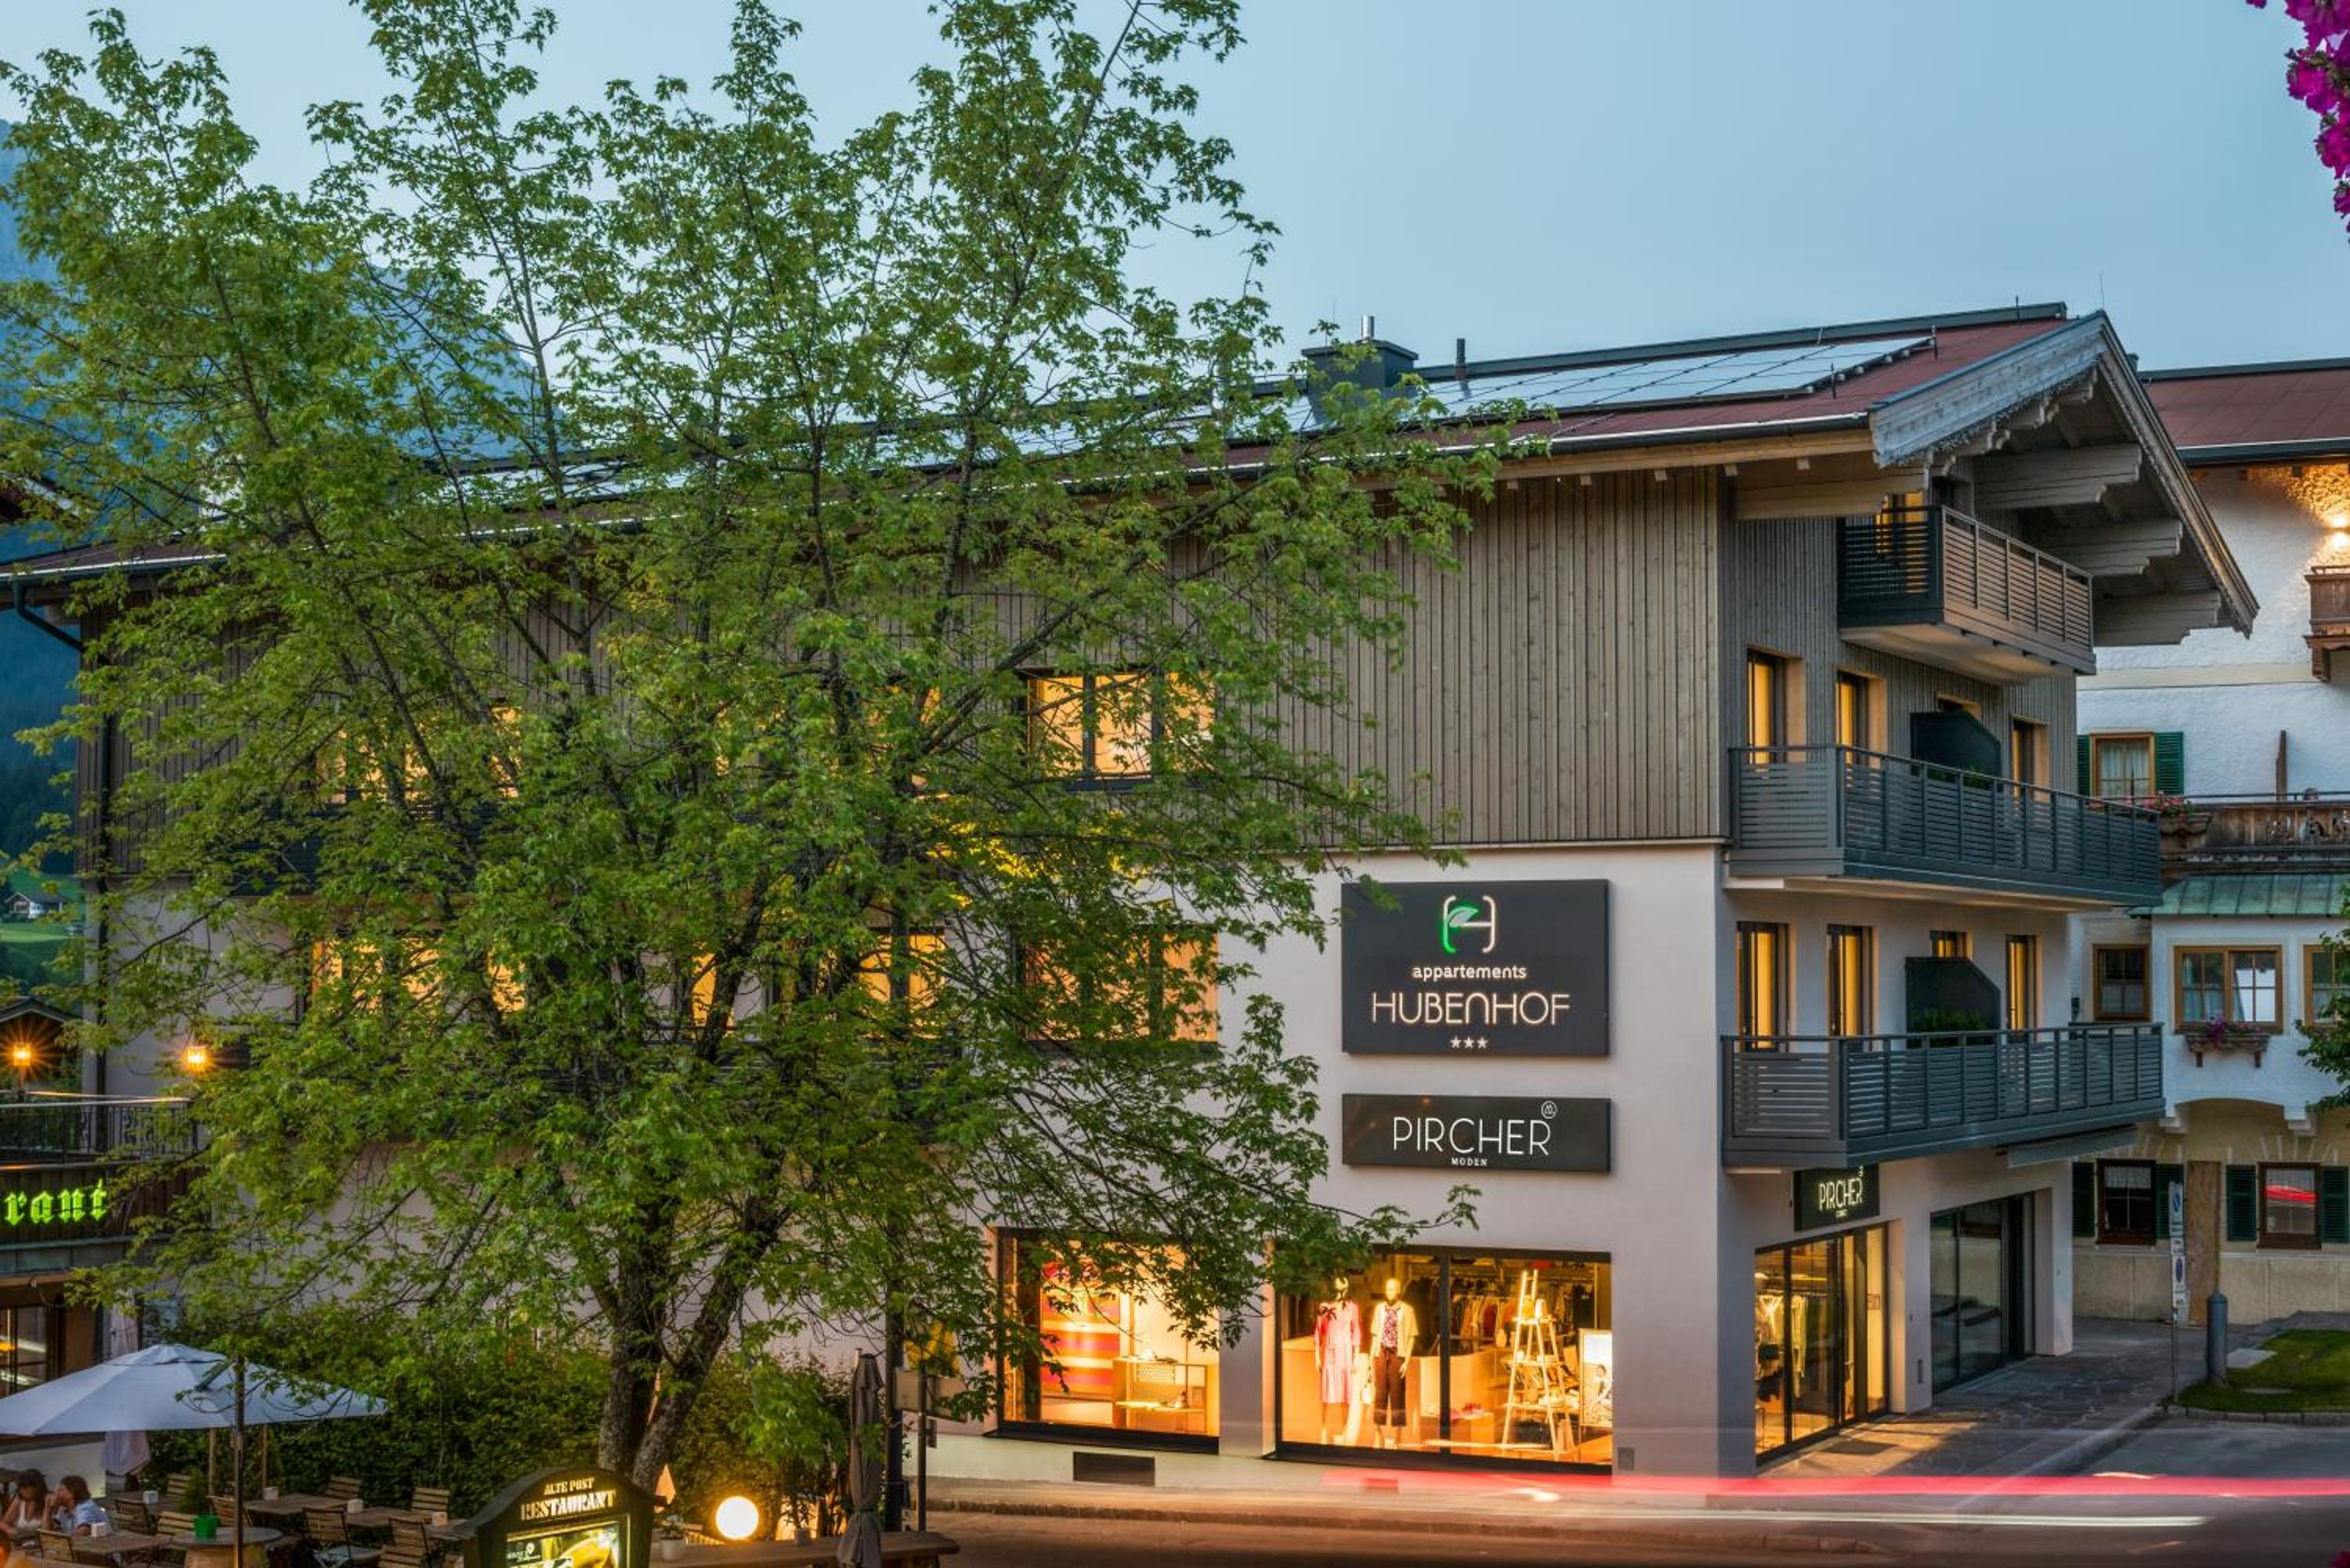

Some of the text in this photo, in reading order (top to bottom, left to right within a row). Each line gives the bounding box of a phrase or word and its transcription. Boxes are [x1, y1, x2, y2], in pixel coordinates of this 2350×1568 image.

[1412, 965, 1528, 981] appartements
[1372, 992, 1570, 1024] HUBENHOF
[1393, 1117, 1551, 1155] PIRCHER
[1452, 1157, 1488, 1166] MODEN
[4, 1178, 107, 1227] rant
[1819, 1177, 1863, 1211] PIRCHER
[544, 1478, 595, 1495] ALTE POST
